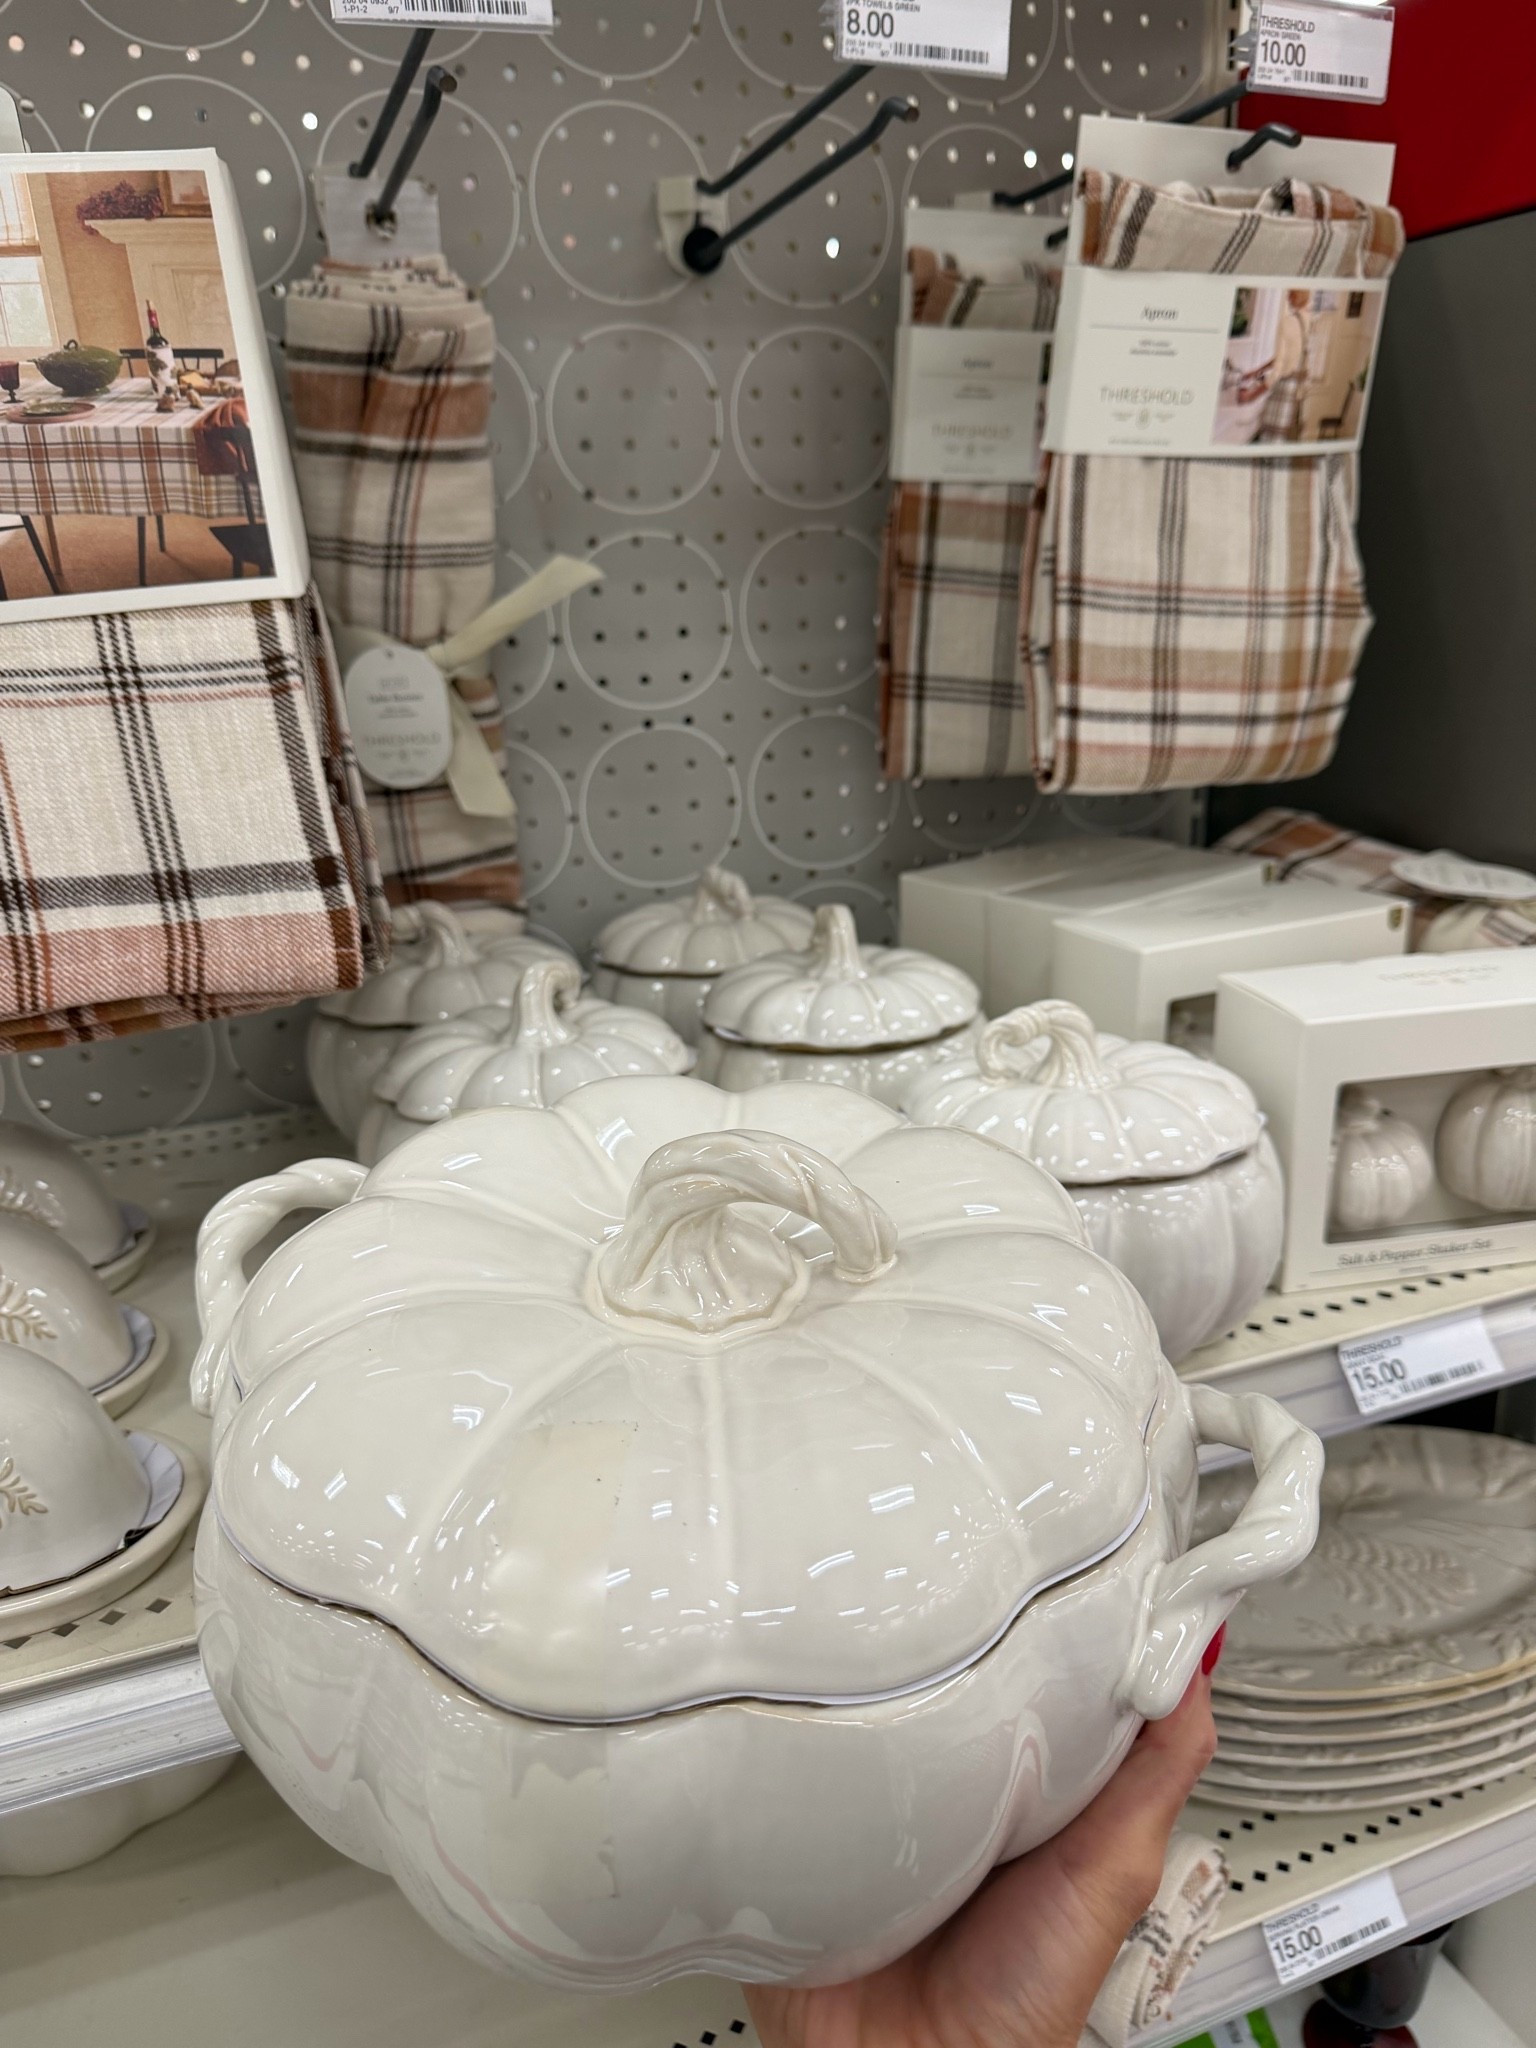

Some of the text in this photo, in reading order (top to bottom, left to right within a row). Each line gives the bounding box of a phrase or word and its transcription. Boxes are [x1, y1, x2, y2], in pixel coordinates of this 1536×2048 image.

[343, 5, 368, 13] 1-P1-2
[894, 2, 921, 12] GREEN
[846, 8, 895, 39] 8.00
[1261, 16, 1315, 33] THRESHOLD
[1260, 39, 1307, 67] 10.00
[1142, 306, 1178, 320] Apron
[1101, 386, 1195, 406] THRESHOLD
[1340, 1253, 1363, 1265] Salt
[1379, 1247, 1423, 1264] Pepper
[1428, 1242, 1467, 1255] Shaker
[1473, 1237, 1492, 1249] Set
[1341, 1335, 1403, 1361] THRESHOLD
[1352, 1358, 1407, 1391] 15.00
[1265, 1902, 1320, 1929] THRESHOLD
[1273, 1924, 1323, 1963] 15.00
